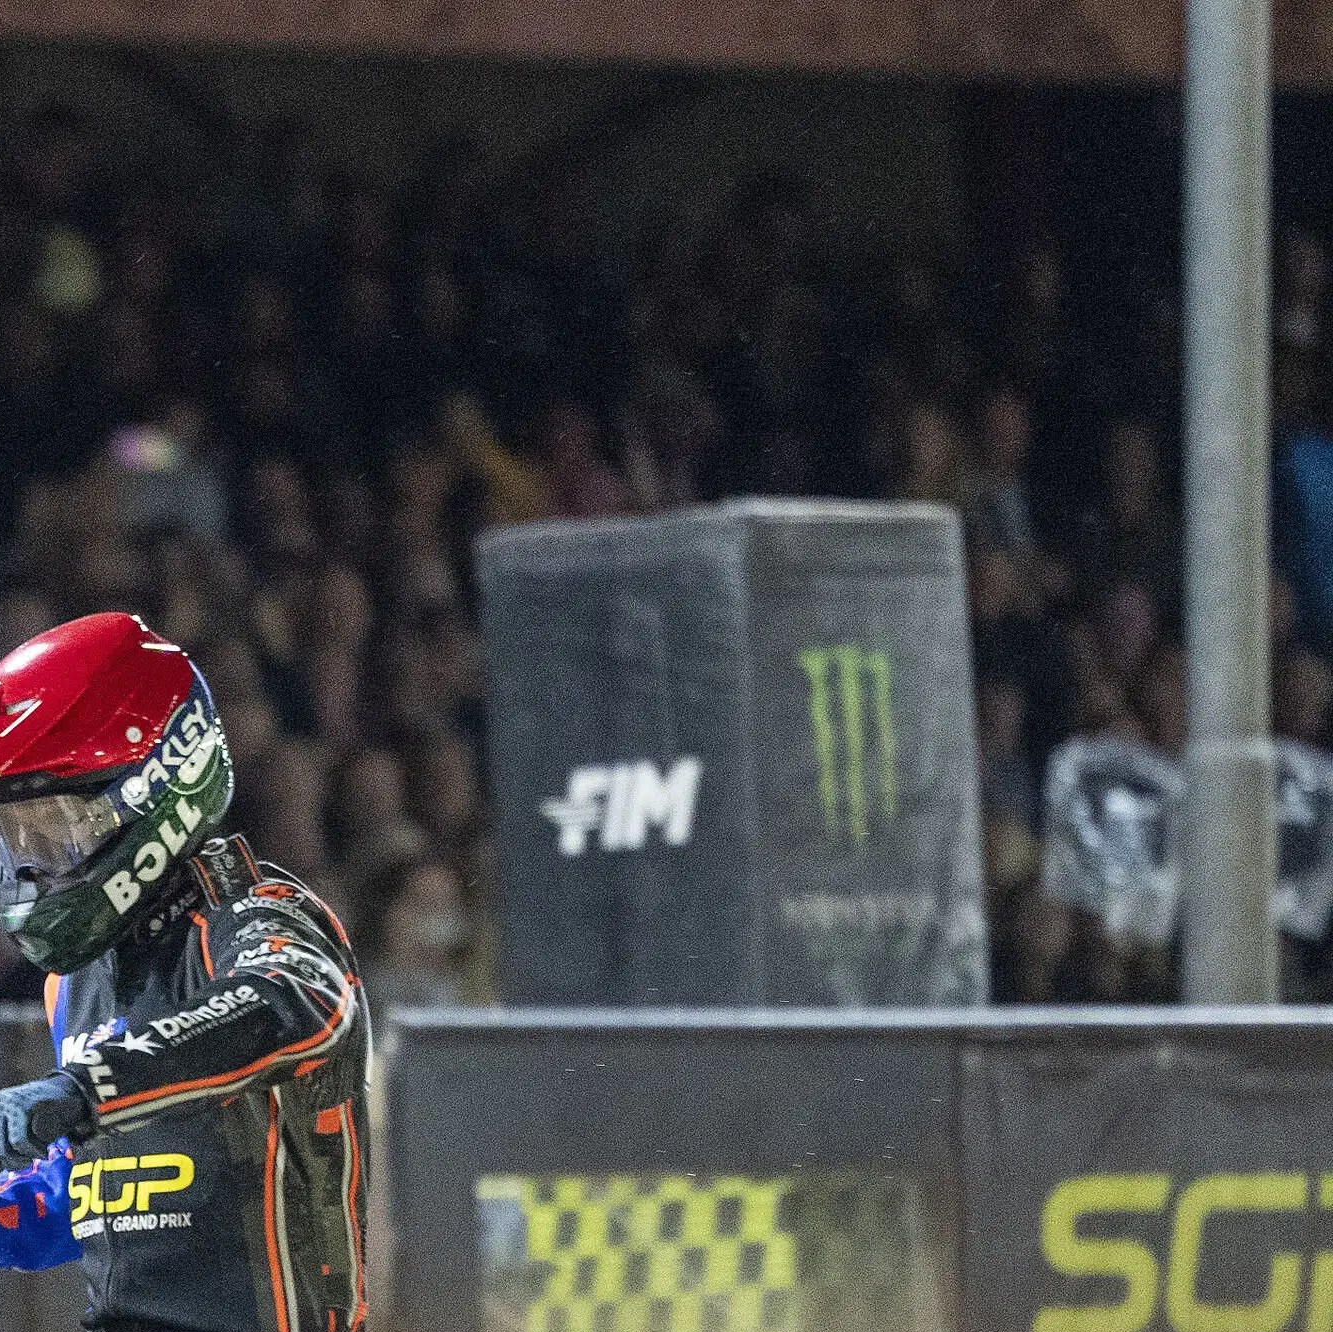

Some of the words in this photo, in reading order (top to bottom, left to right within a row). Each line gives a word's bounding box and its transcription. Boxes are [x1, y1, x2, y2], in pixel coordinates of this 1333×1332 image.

[540, 755, 702, 857] FIM
[103, 797, 202, 914] BOLL
[68, 1153, 195, 1222] SGP
[113, 1214, 158, 1232] GRAND
[160, 1212, 192, 1229] PRIX
